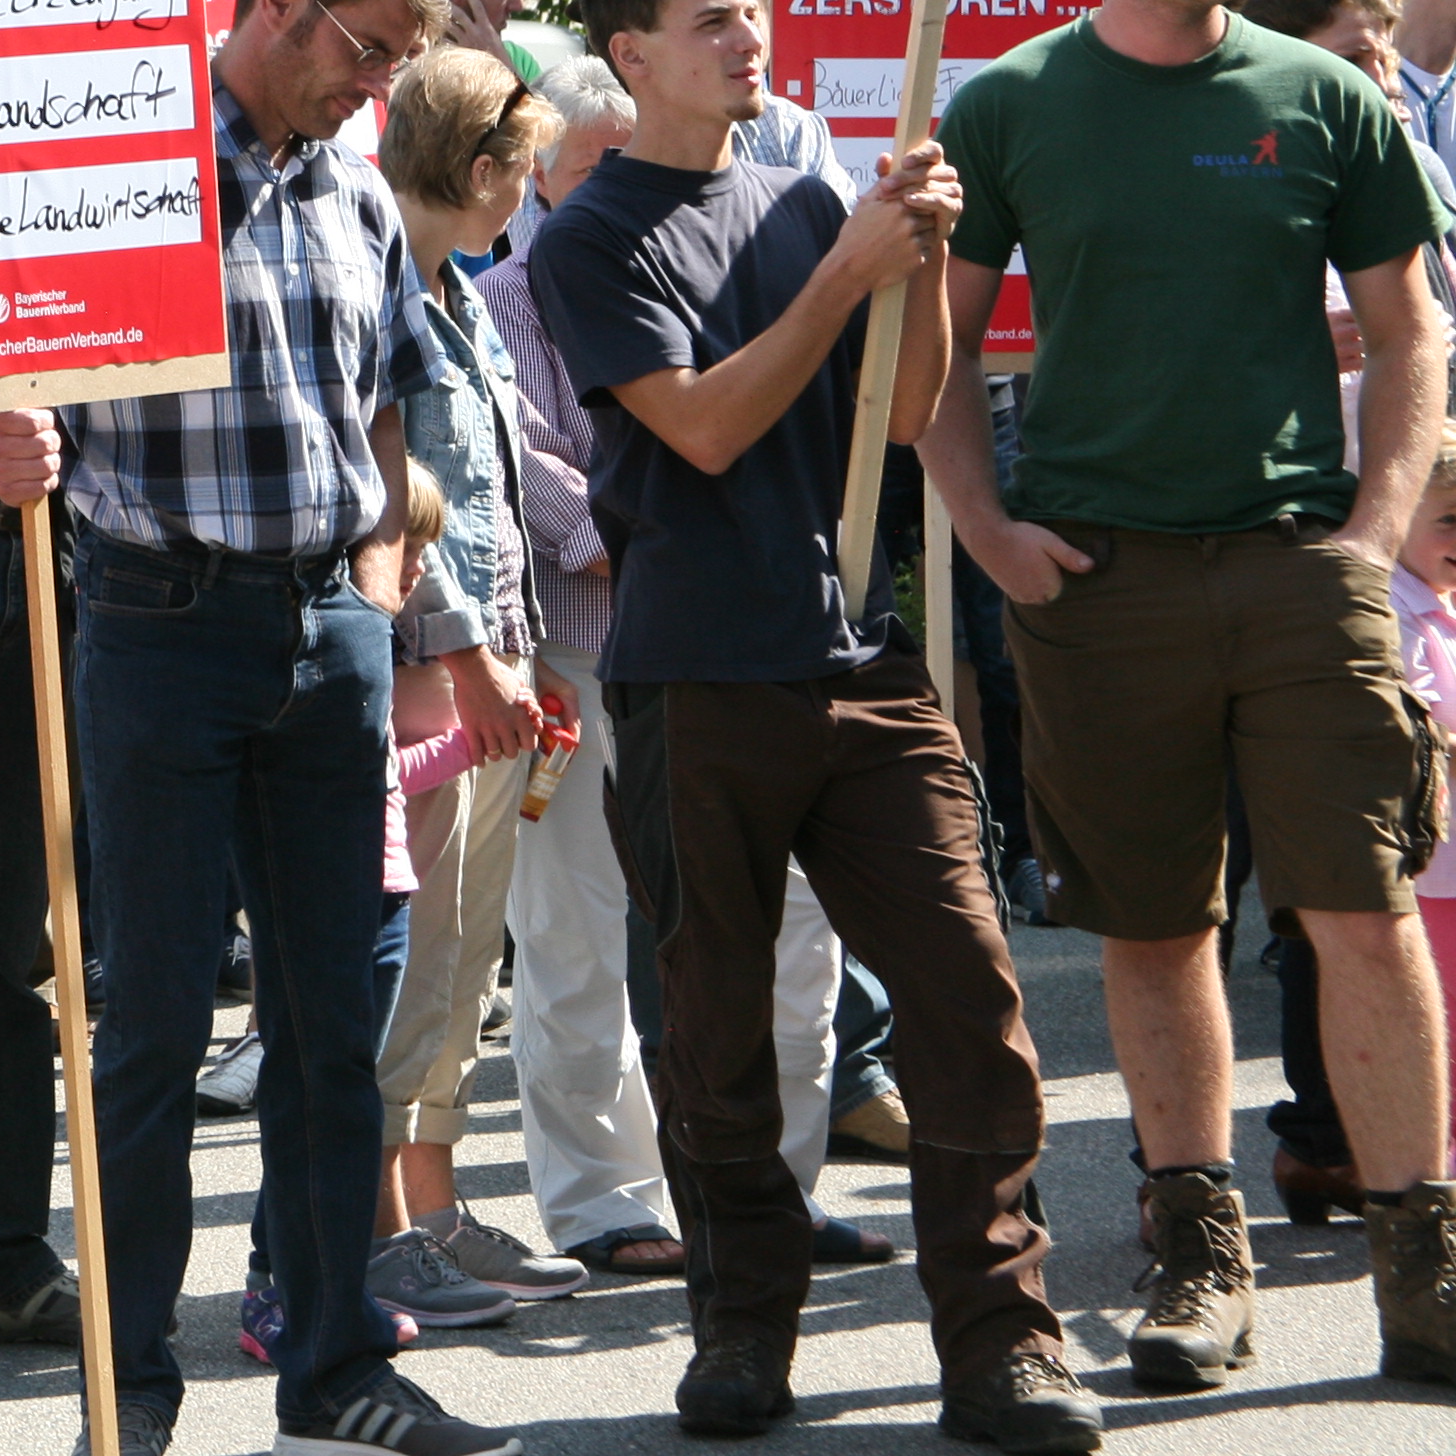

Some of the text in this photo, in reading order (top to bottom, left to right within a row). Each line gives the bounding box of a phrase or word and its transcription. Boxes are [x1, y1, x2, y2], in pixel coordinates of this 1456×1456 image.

[1193, 154, 1248, 166] DEULA
[18, 176, 205, 235] Landwirtschaft
[15, 289, 67, 306] Bayerischer
[16, 301, 86, 319] BauernVerband
